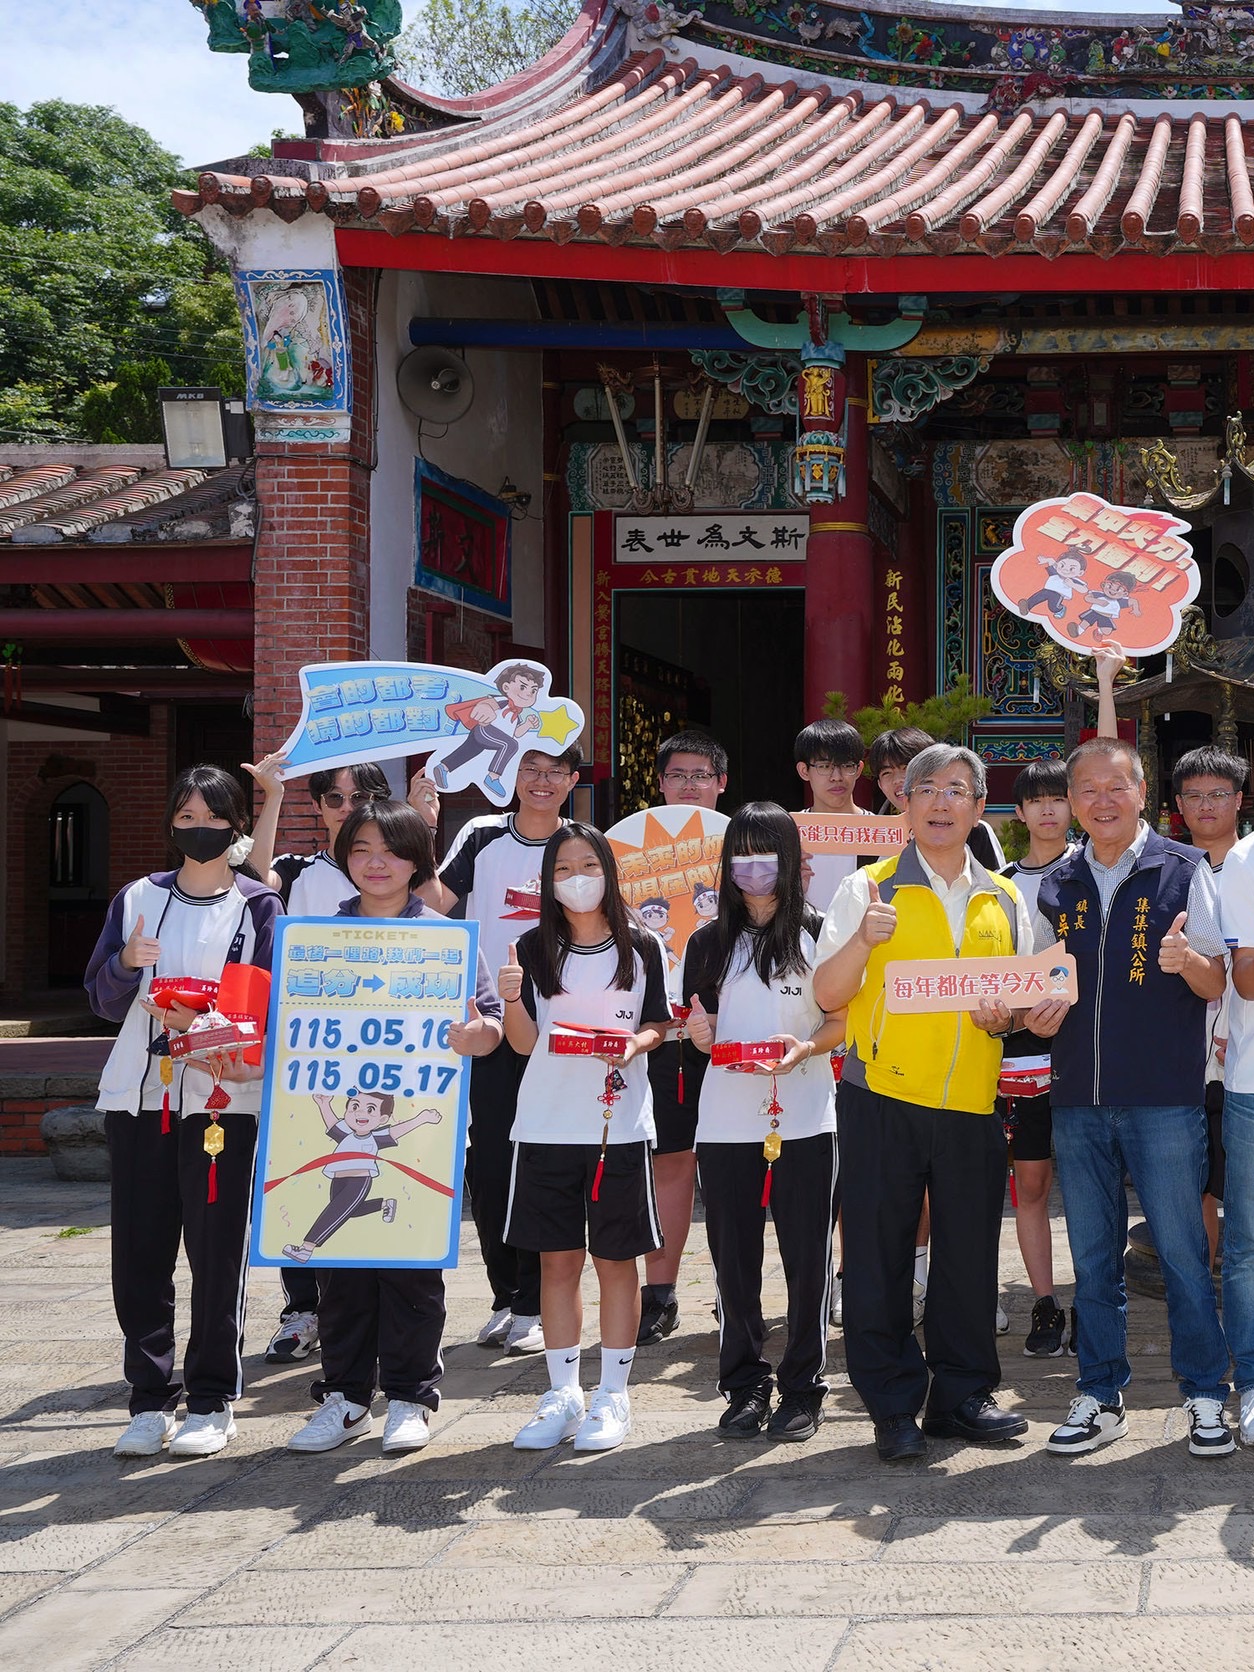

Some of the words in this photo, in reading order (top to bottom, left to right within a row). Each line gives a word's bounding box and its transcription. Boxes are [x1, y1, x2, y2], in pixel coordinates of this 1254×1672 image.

[797, 824, 904, 845] 不能只有我看到
[616, 835, 724, 880] 未來的你
[1057, 913, 1070, 941] 吳
[1074, 898, 1089, 931] 鎮長
[1128, 897, 1152, 986] 集集鎮公所
[286, 968, 361, 998] 追分
[388, 969, 463, 1000] 成功
[780, 985, 802, 997] JIJI
[893, 971, 1045, 999] 每年都在等今天
[616, 1010, 634, 1020] JIJI
[287, 1017, 450, 1053] 115.05.16
[286, 1060, 456, 1098] 115.05.17
